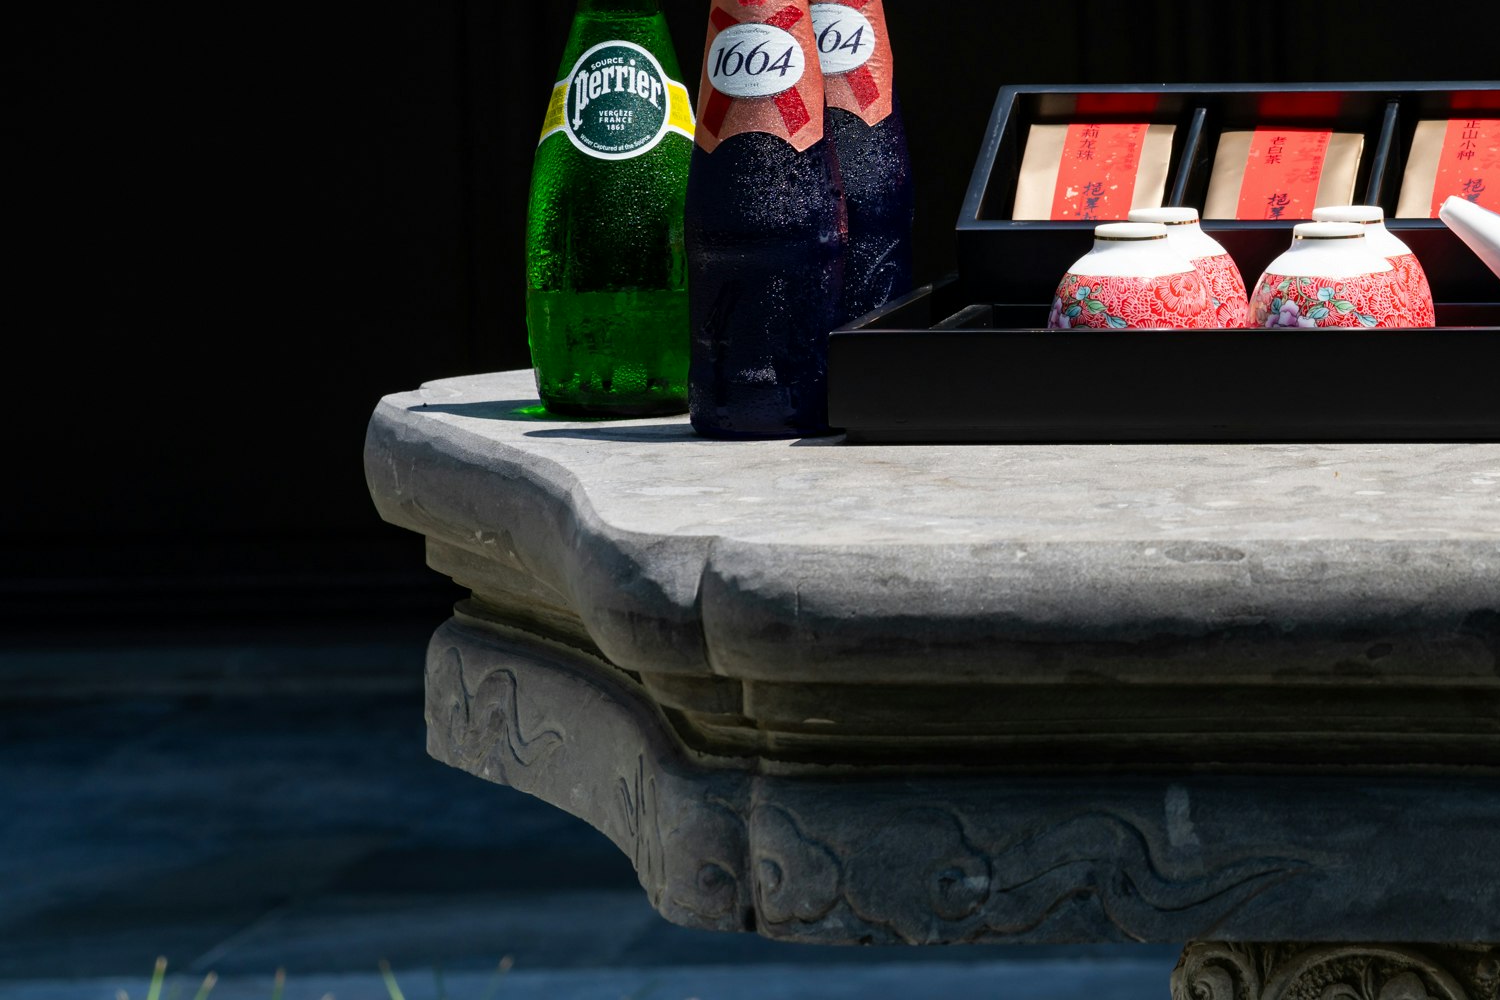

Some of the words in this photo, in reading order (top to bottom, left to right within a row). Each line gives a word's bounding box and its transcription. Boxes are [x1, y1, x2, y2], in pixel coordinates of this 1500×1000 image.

[812, 19, 867, 55] 64
[591, 57, 624, 70] SOURCE
[713, 40, 795, 77] 1664
[599, 109, 633, 117] VERGÈZE
[1076, 124, 1100, 161] 莉龙珠
[1264, 136, 1287, 165] 老白茶
